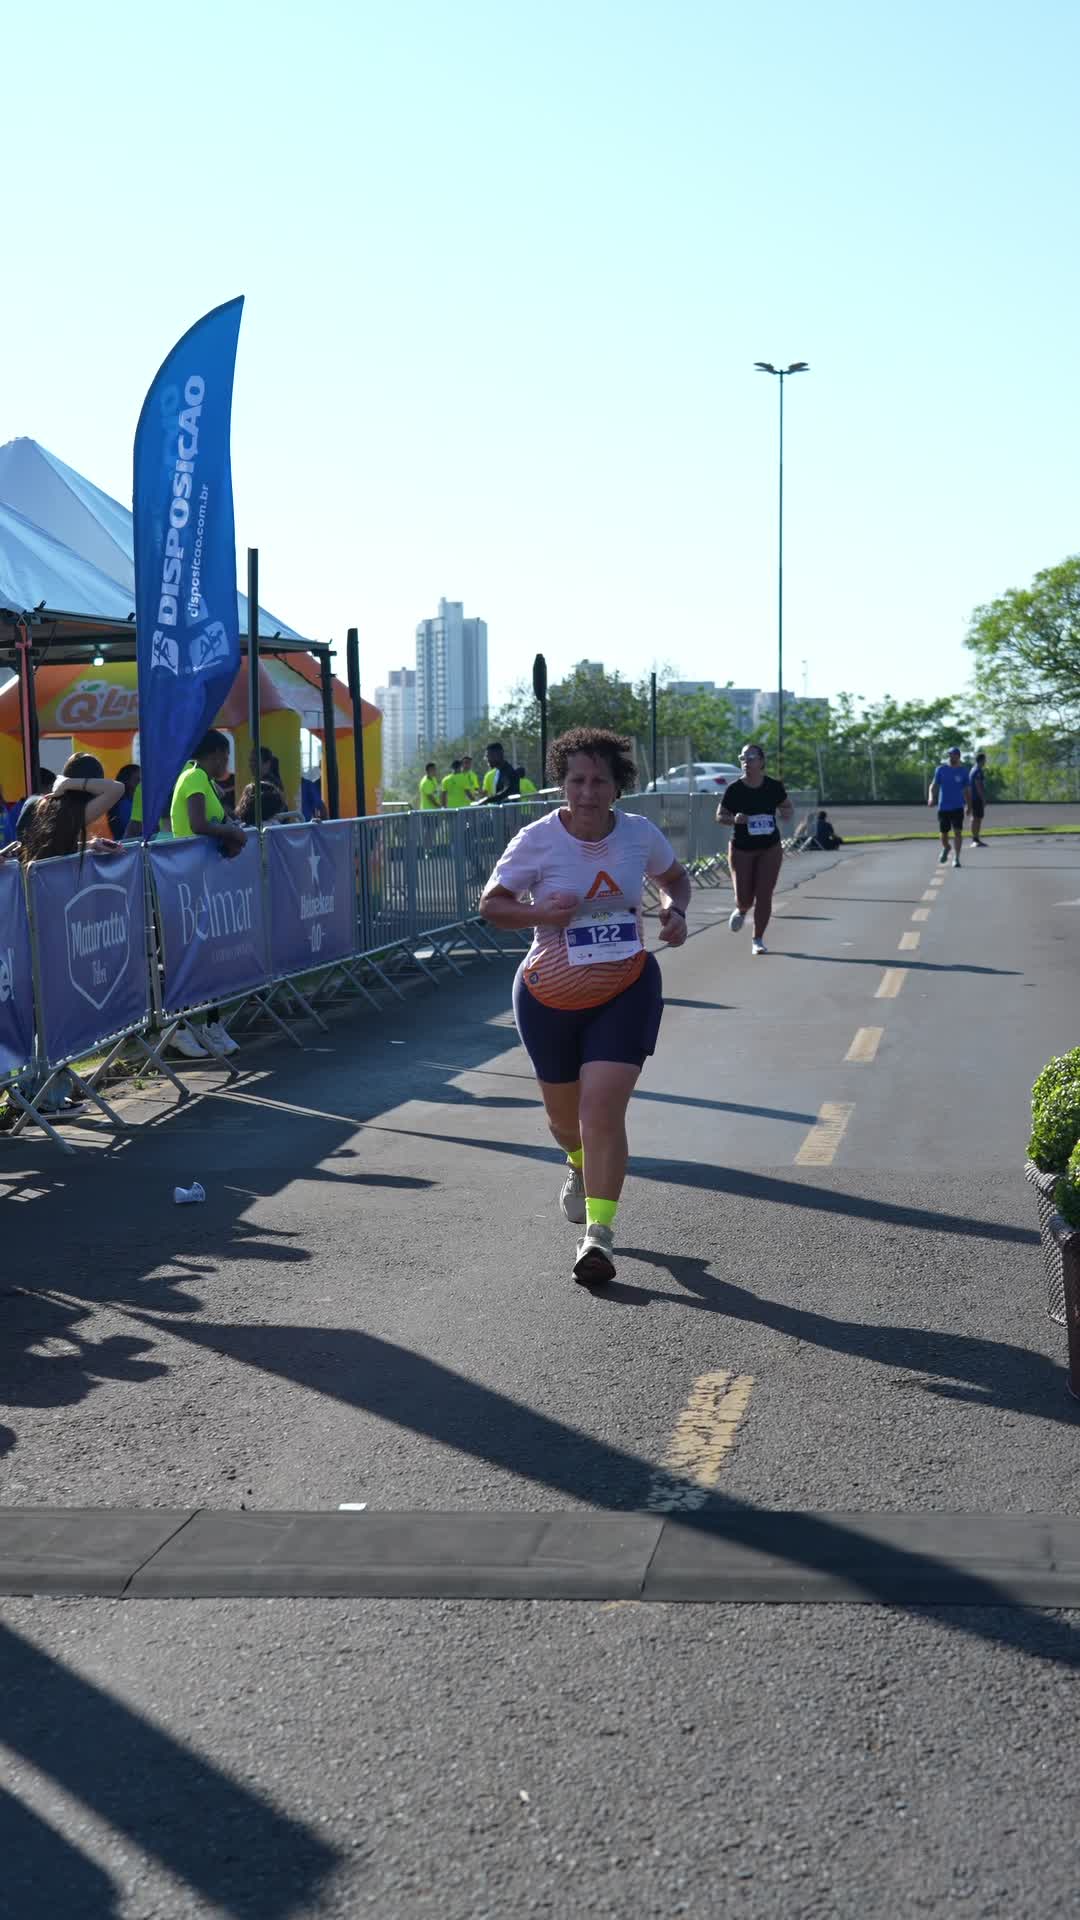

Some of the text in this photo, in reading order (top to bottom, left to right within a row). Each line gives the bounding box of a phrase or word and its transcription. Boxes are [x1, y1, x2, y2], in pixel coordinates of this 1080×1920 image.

[188, 483, 209, 618] disposicao.com.br
[177, 872, 253, 945] Belmar
[588, 924, 622, 944] 122
